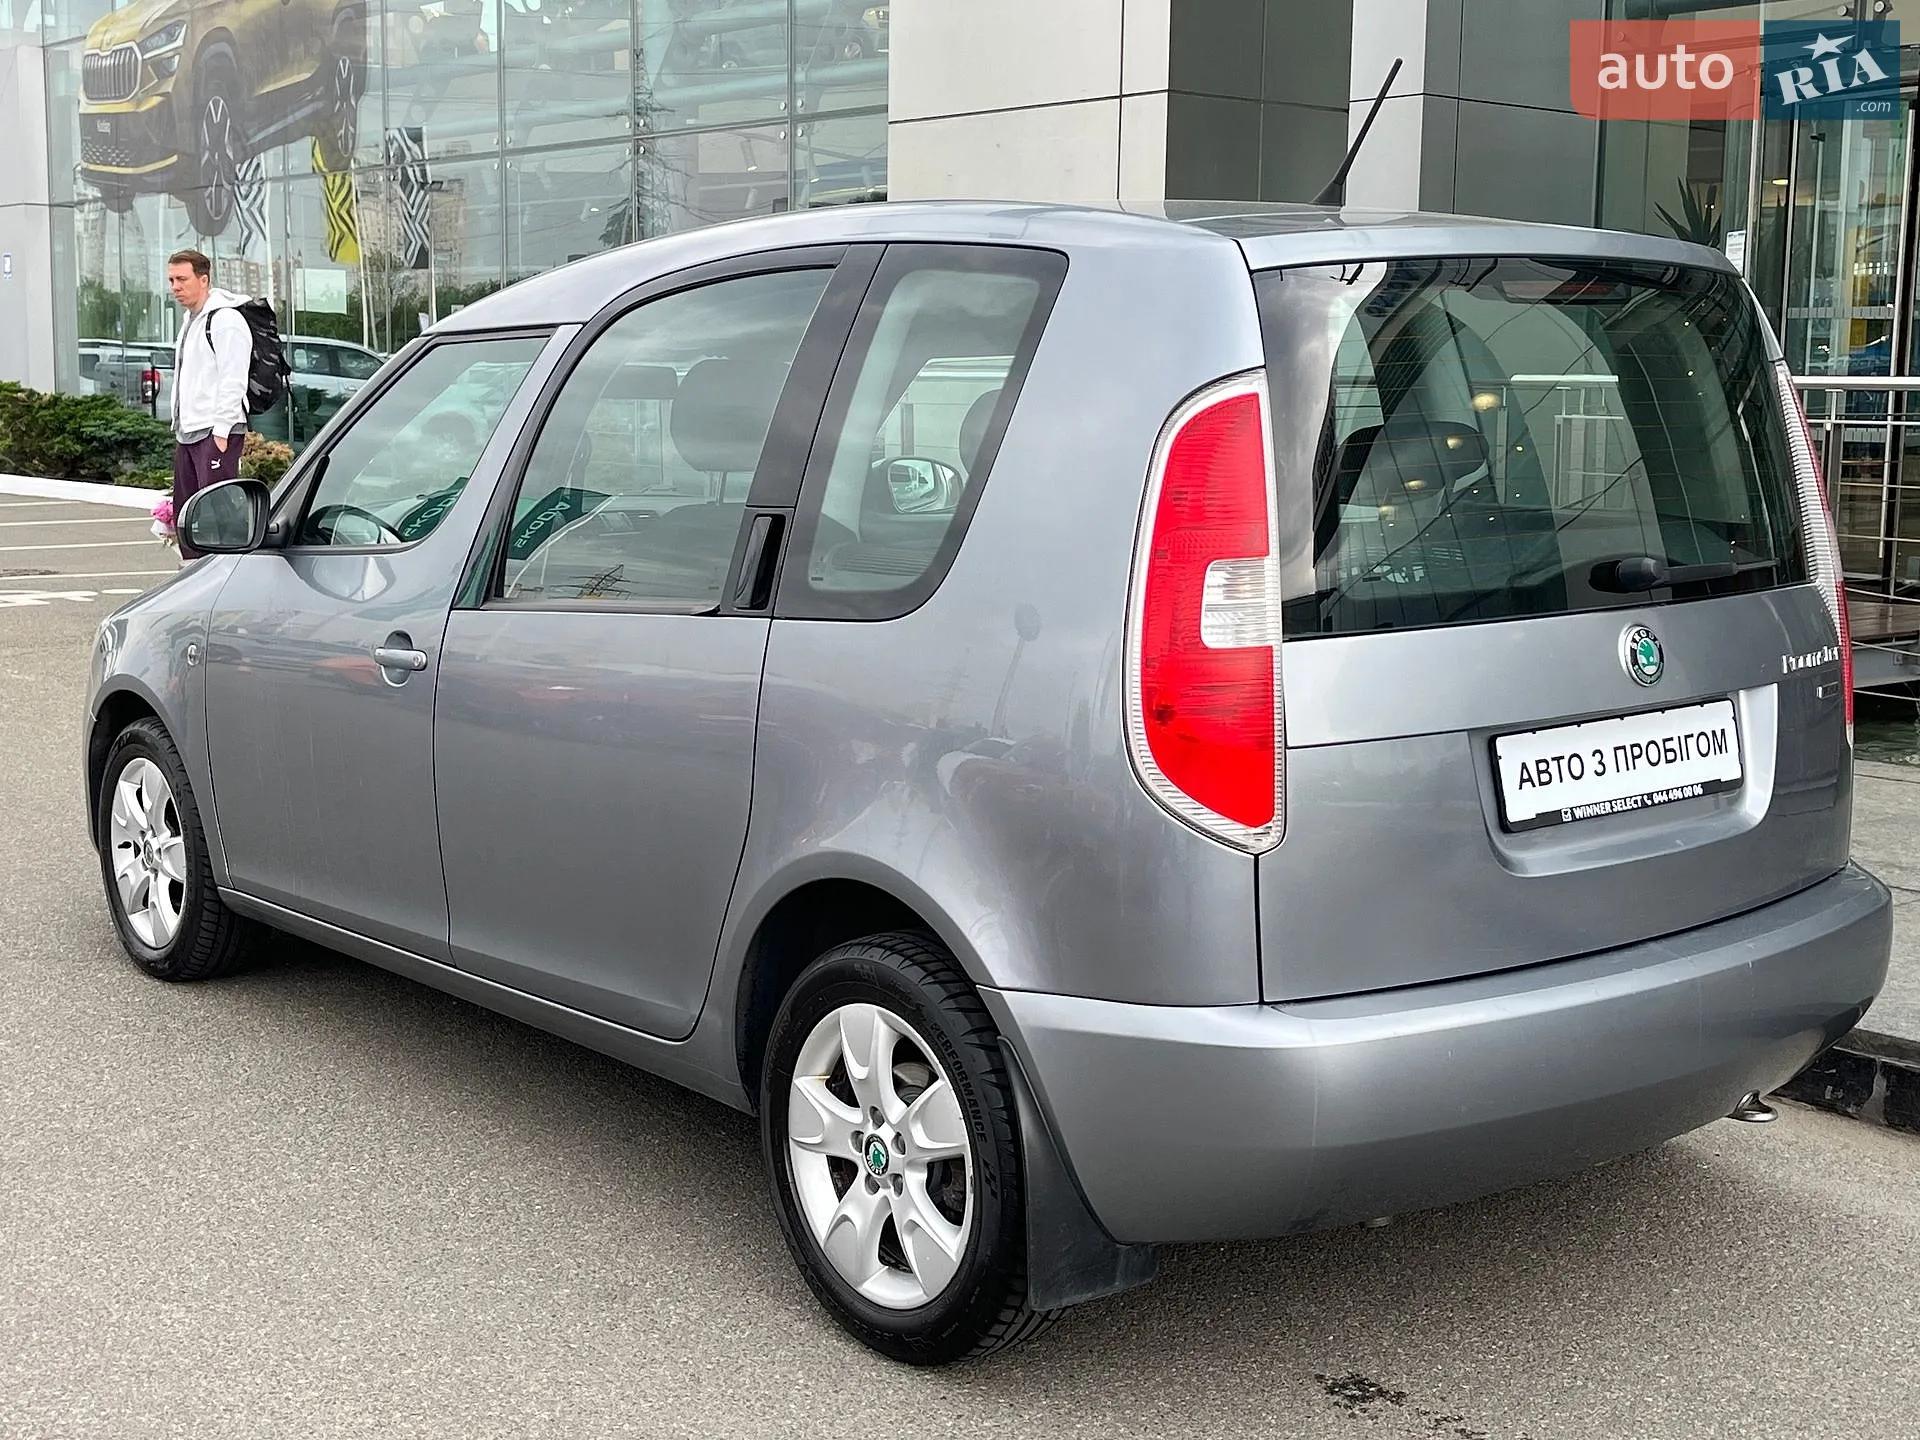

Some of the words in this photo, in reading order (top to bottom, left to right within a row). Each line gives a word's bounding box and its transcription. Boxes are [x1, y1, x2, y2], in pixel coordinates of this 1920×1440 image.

[1518, 752, 1585, 790] АВТО
[1612, 728, 1729, 773] ПРОБІГОМ
[1572, 801, 1613, 820] WINNER
[1611, 794, 1643, 813] SELECT
